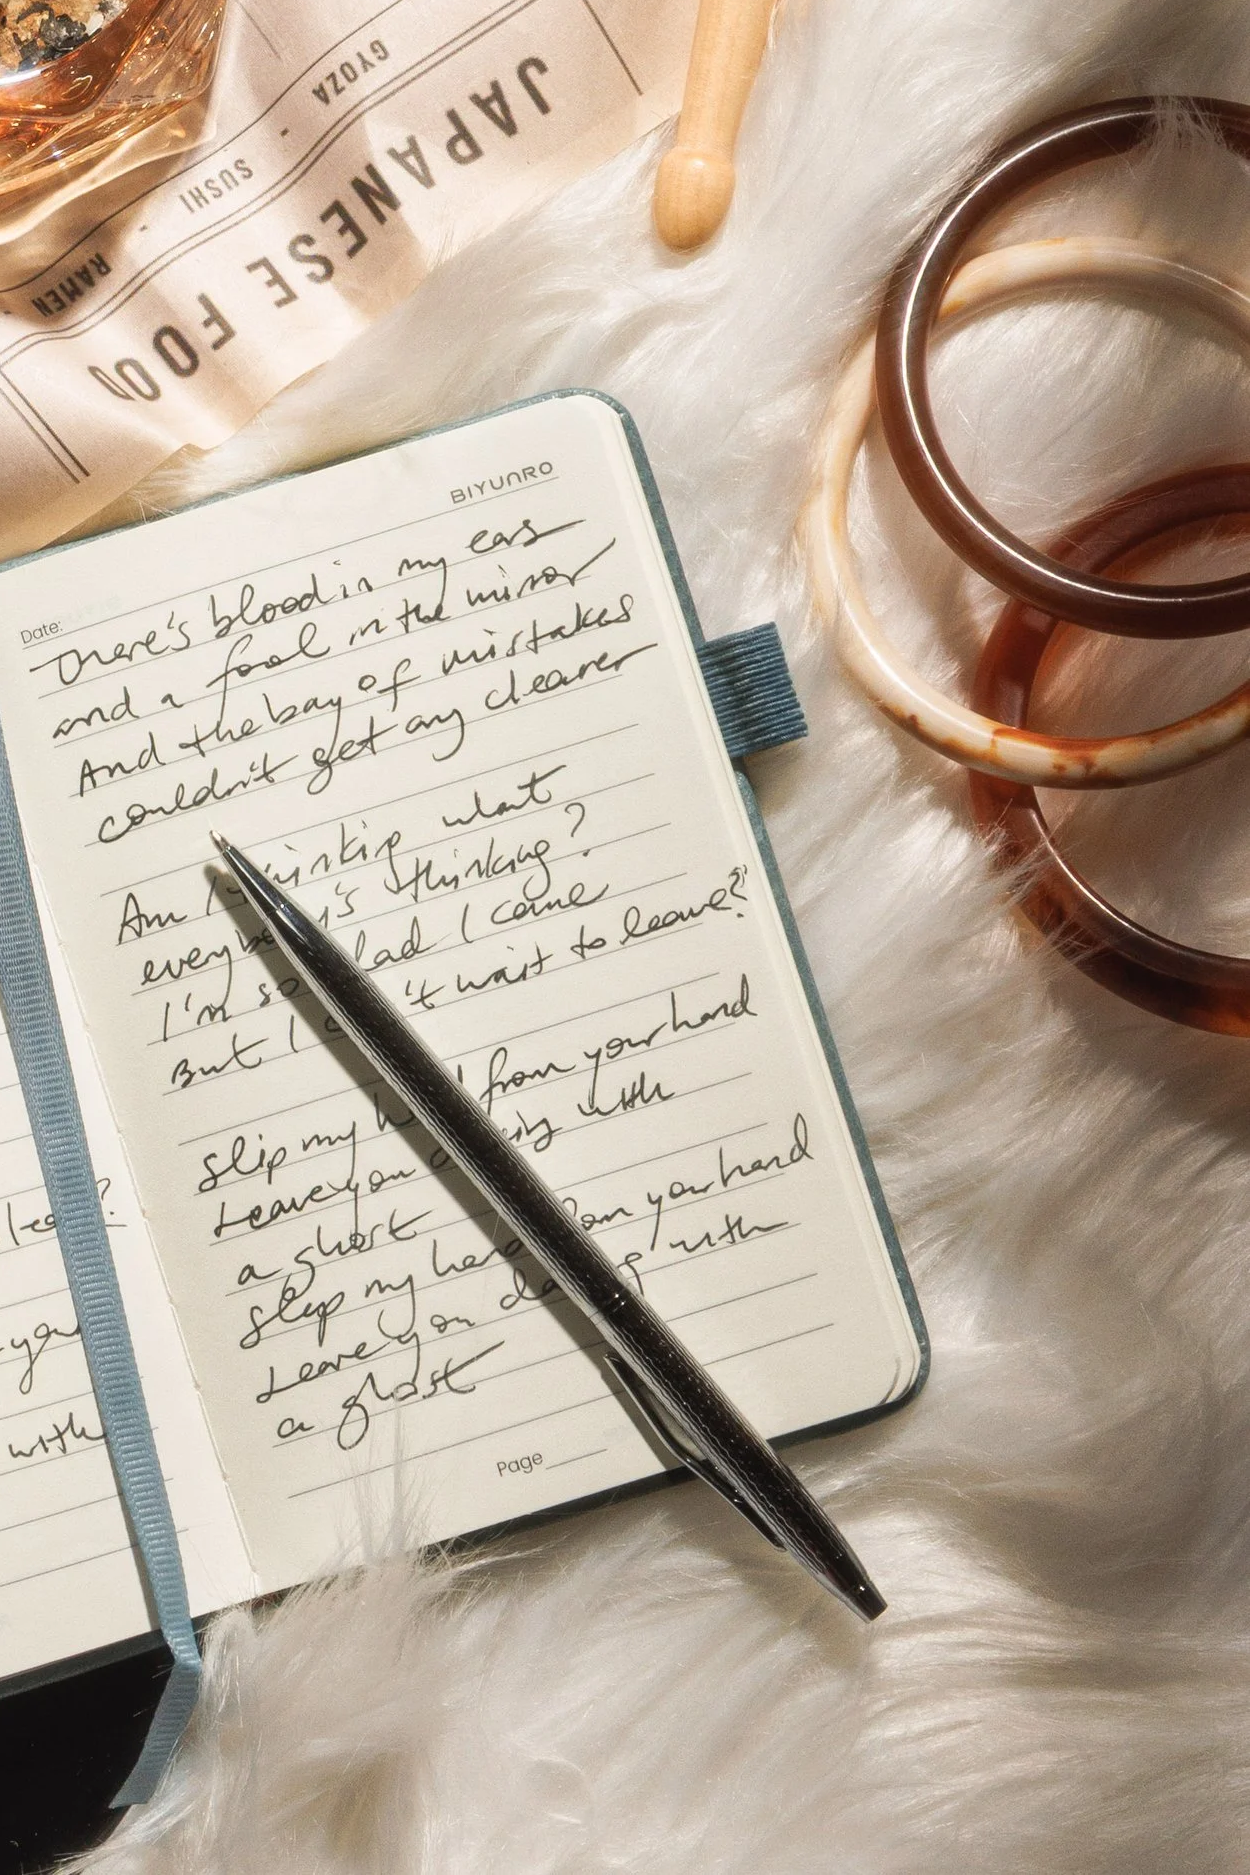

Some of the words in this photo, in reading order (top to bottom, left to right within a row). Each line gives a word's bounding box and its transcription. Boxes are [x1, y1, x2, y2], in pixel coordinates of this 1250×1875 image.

[311, 39, 389, 105] GYOZA
[178, 157, 253, 213] SUSHI
[244, 56, 551, 308] JAPANESE
[31, 251, 111, 316] RAMEN
[20, 619, 64, 646] Date:
[211, 573, 320, 639] blood
[442, 593, 635, 676] mistakes
[98, 748, 299, 844] couldn't
[490, 883, 610, 928] came
[478, 1048, 576, 1104] from
[9, 1412, 106, 1458] with
[496, 1452, 544, 1479] Page
